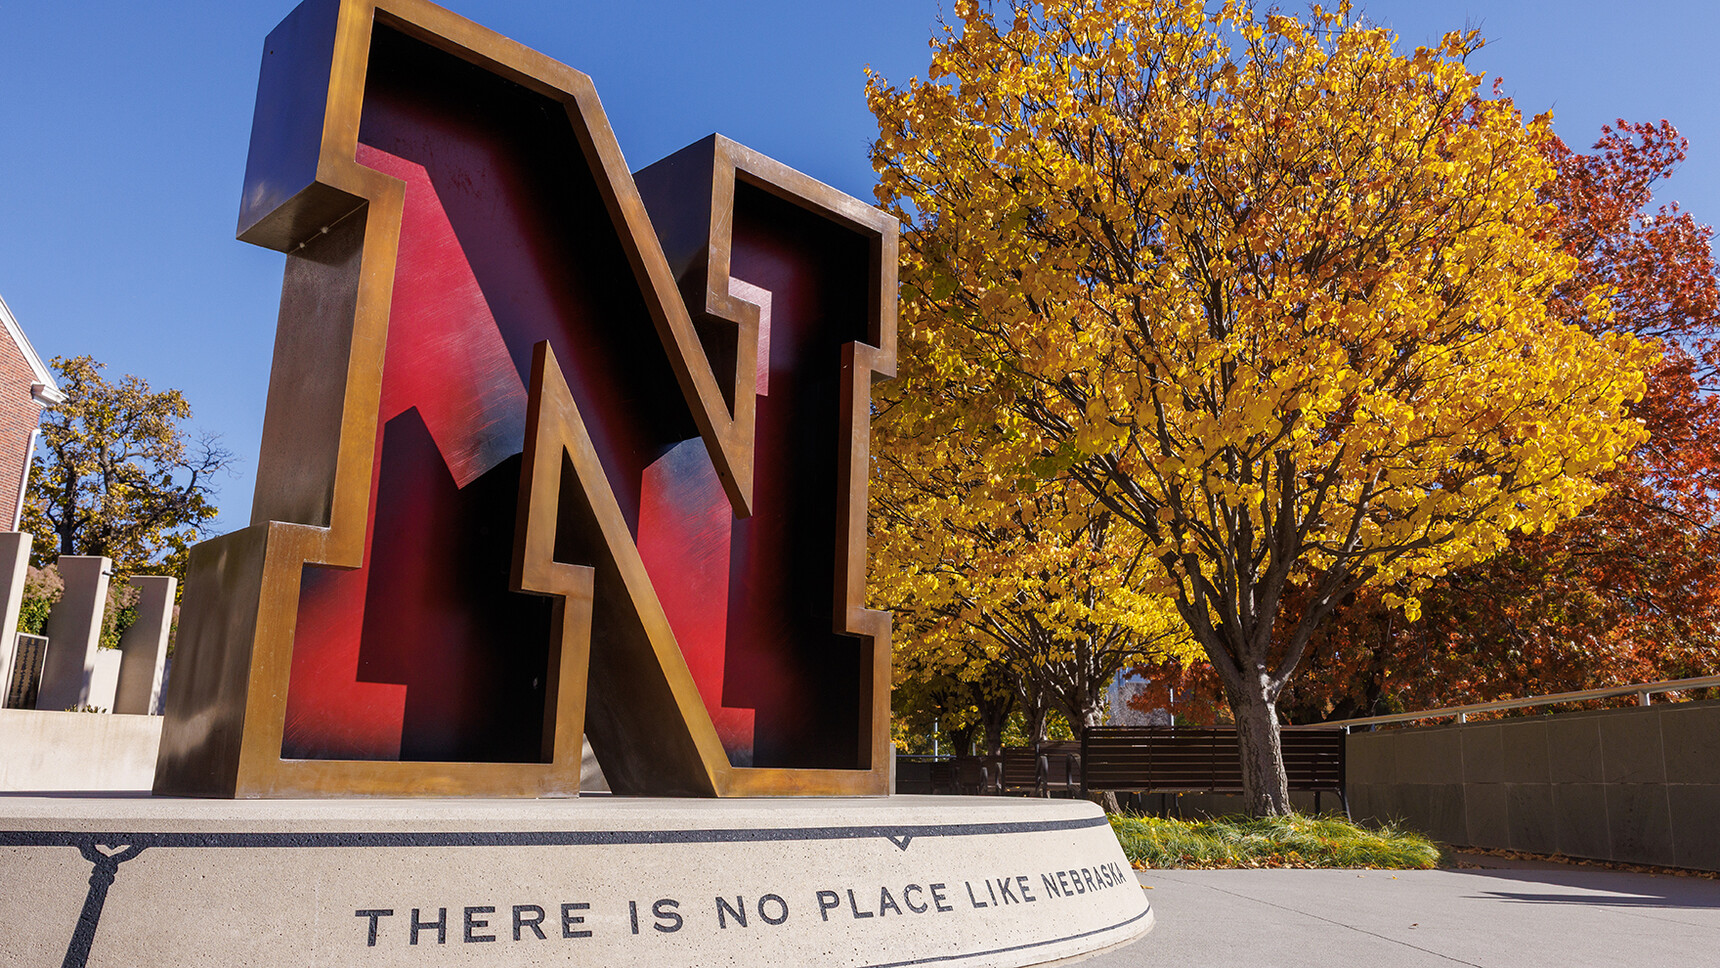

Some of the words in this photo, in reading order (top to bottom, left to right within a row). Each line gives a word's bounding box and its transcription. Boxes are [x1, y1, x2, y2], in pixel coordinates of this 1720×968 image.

[232, 0, 900, 798] N
[354, 902, 593, 947] THERE
[628, 899, 684, 935] IS
[715, 894, 789, 930] NO
[815, 883, 954, 922] PLACE
[964, 875, 1037, 909] LIKE
[1040, 861, 1128, 899] NEBRASKA
